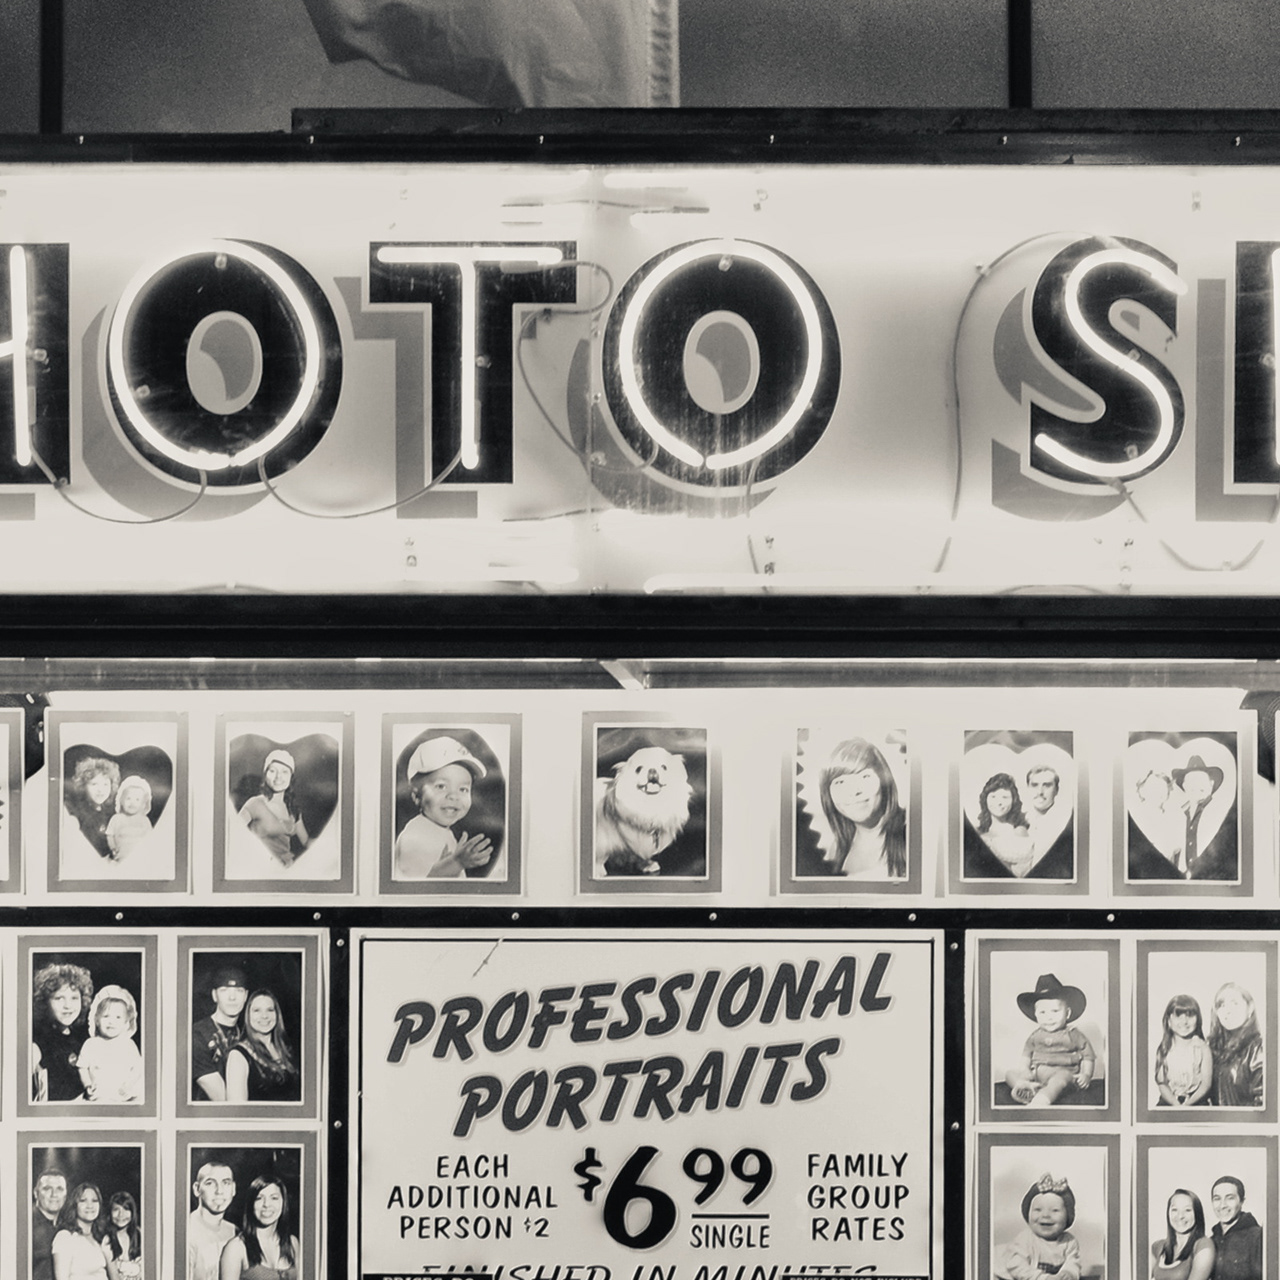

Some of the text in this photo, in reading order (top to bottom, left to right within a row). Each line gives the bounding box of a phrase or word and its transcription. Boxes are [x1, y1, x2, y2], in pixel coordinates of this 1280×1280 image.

[387, 951, 893, 1065] PROFESSIONAL
[453, 1037, 841, 1138] PORTRAITS
[436, 1154, 509, 1180] EACH
[807, 1152, 908, 1178] FAMILY
[387, 1185, 558, 1209] ADDITIONAL
[807, 1184, 910, 1210] GROUP
[400, 1215, 550, 1239] PERSON $2
[690, 1224, 770, 1248] SINGLE
[811, 1216, 905, 1241] RATES
